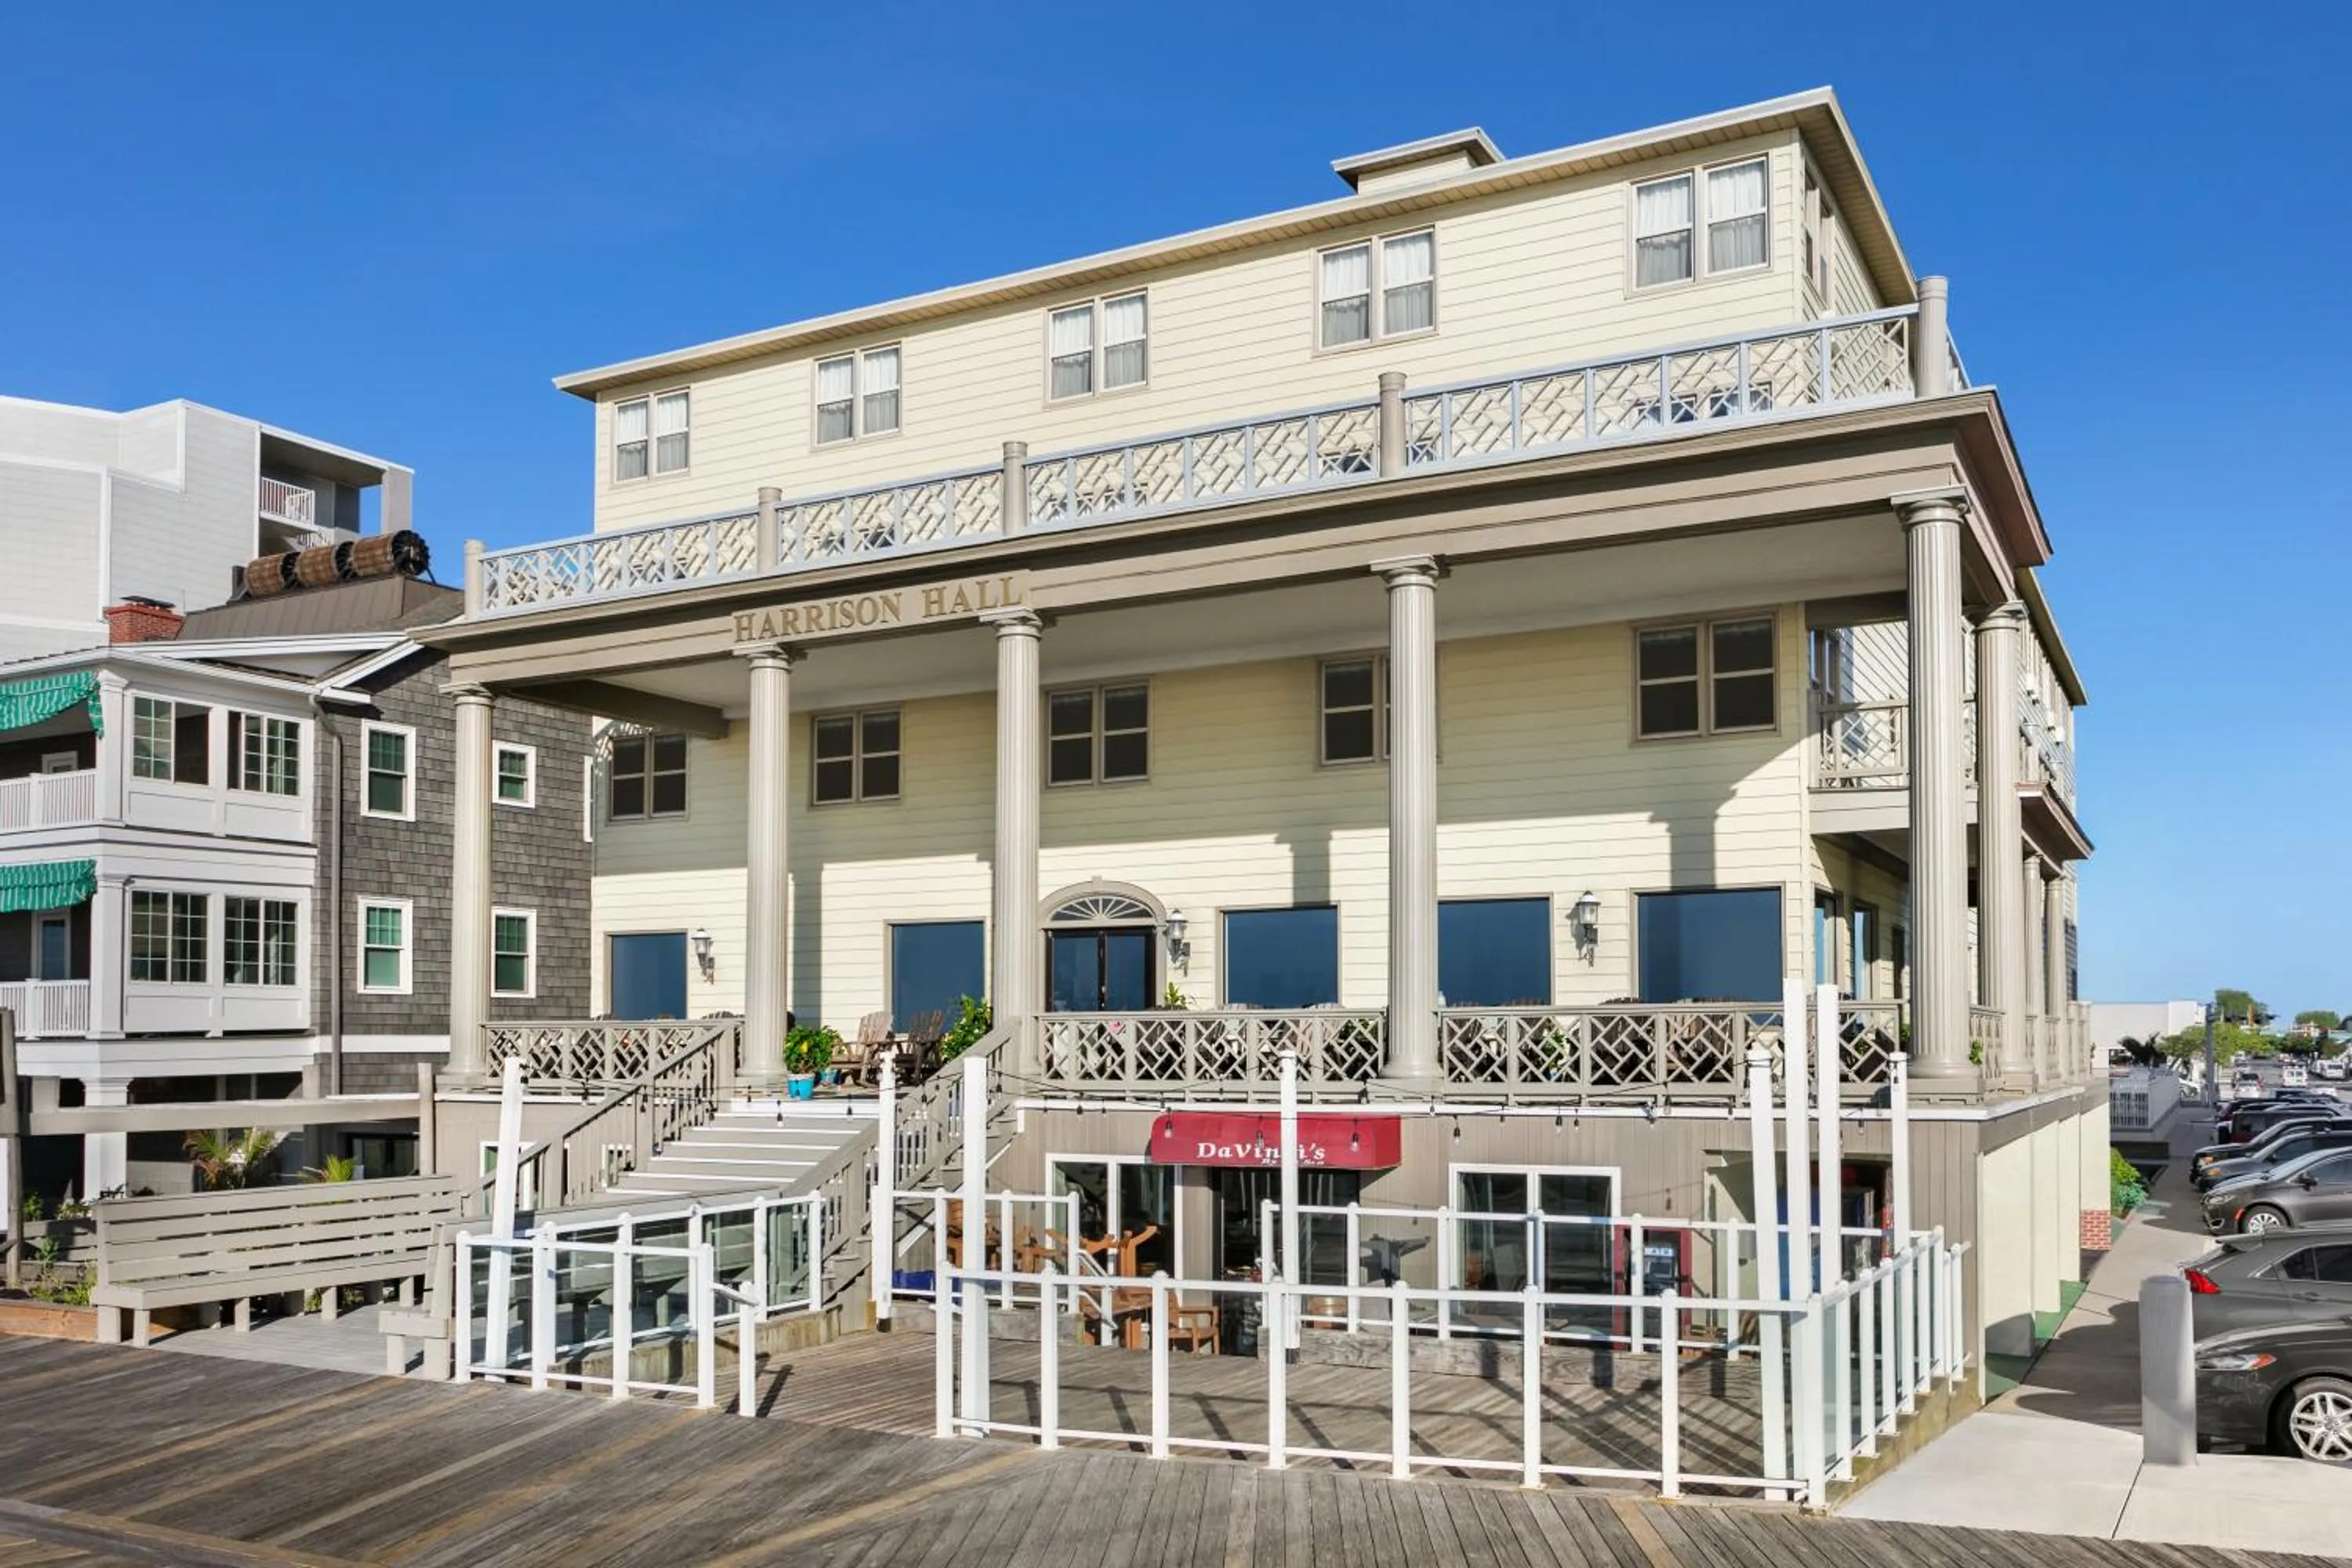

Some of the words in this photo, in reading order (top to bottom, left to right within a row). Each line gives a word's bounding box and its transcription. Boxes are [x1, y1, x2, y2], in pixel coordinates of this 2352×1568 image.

[733, 592, 902, 643] HARRISON
[921, 576, 1022, 619] HALL
[1196, 1142, 1327, 1160] DaVini's
